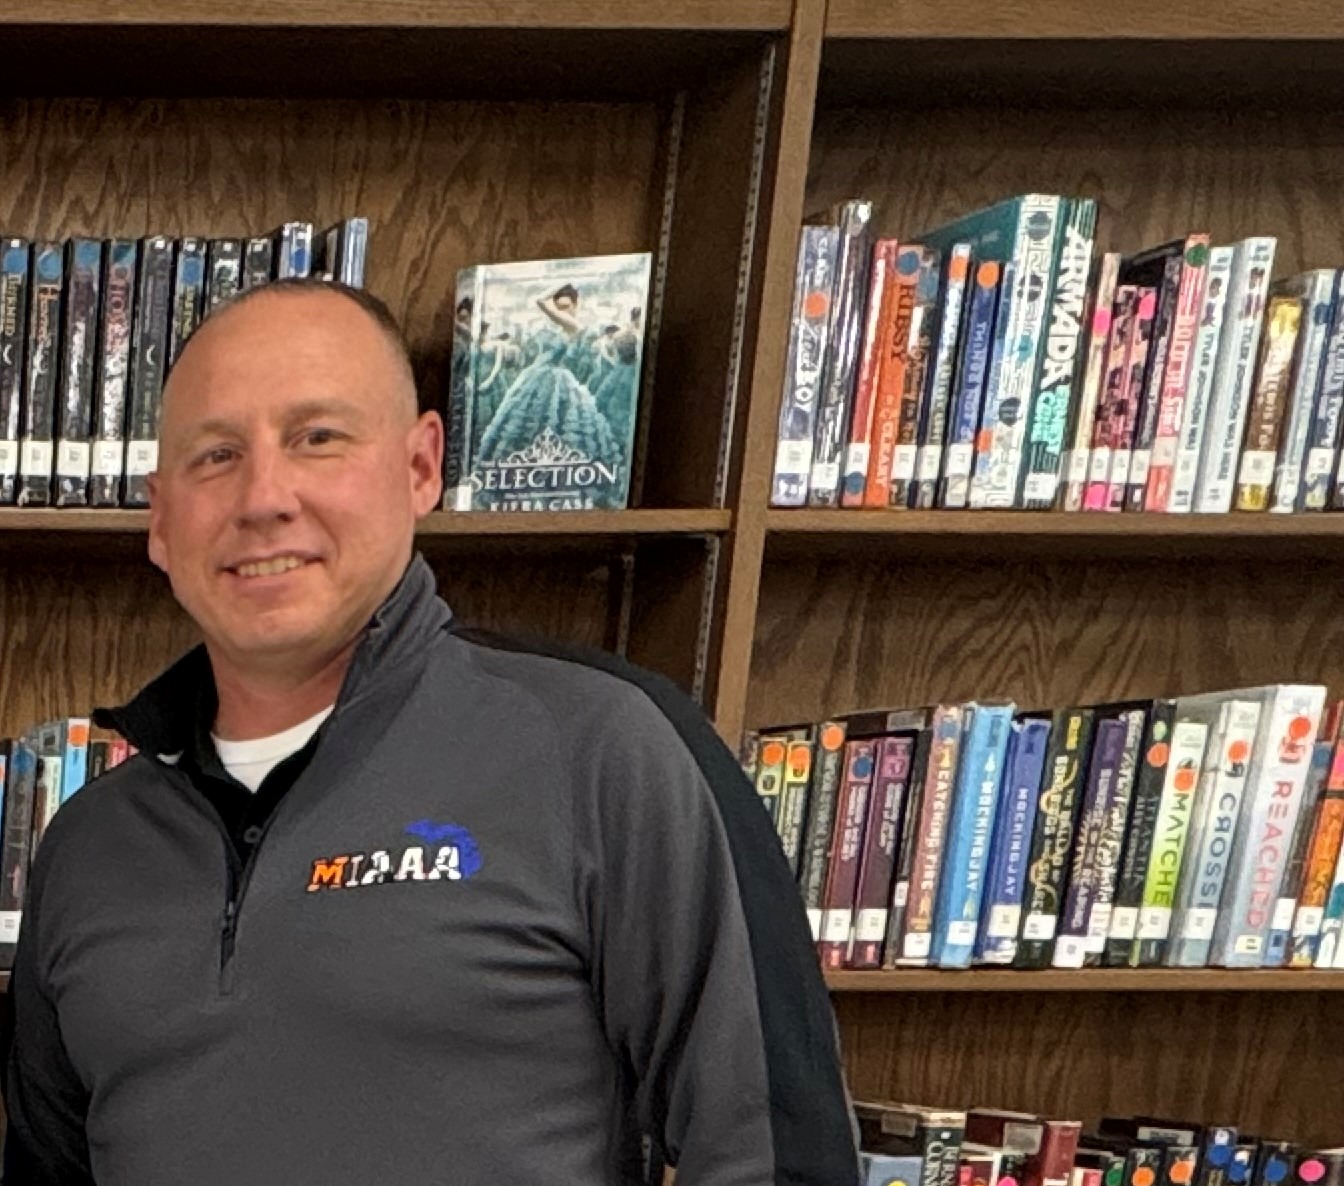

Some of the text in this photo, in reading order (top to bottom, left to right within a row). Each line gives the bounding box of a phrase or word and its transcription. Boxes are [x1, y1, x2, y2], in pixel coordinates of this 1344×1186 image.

[1041, 226, 1093, 389] ARMADA
[471, 460, 618, 492] SELECTION
[876, 422, 897, 487] CLEARY
[306, 847, 462, 891] MIAA
[966, 781, 994, 892] MOCKINGJAY
[1004, 788, 1030, 895] MOCKINGJAY
[1155, 793, 1190, 907] MATCHE
[1199, 793, 1236, 907] CROSS
[1245, 780, 1293, 929] REACHED
